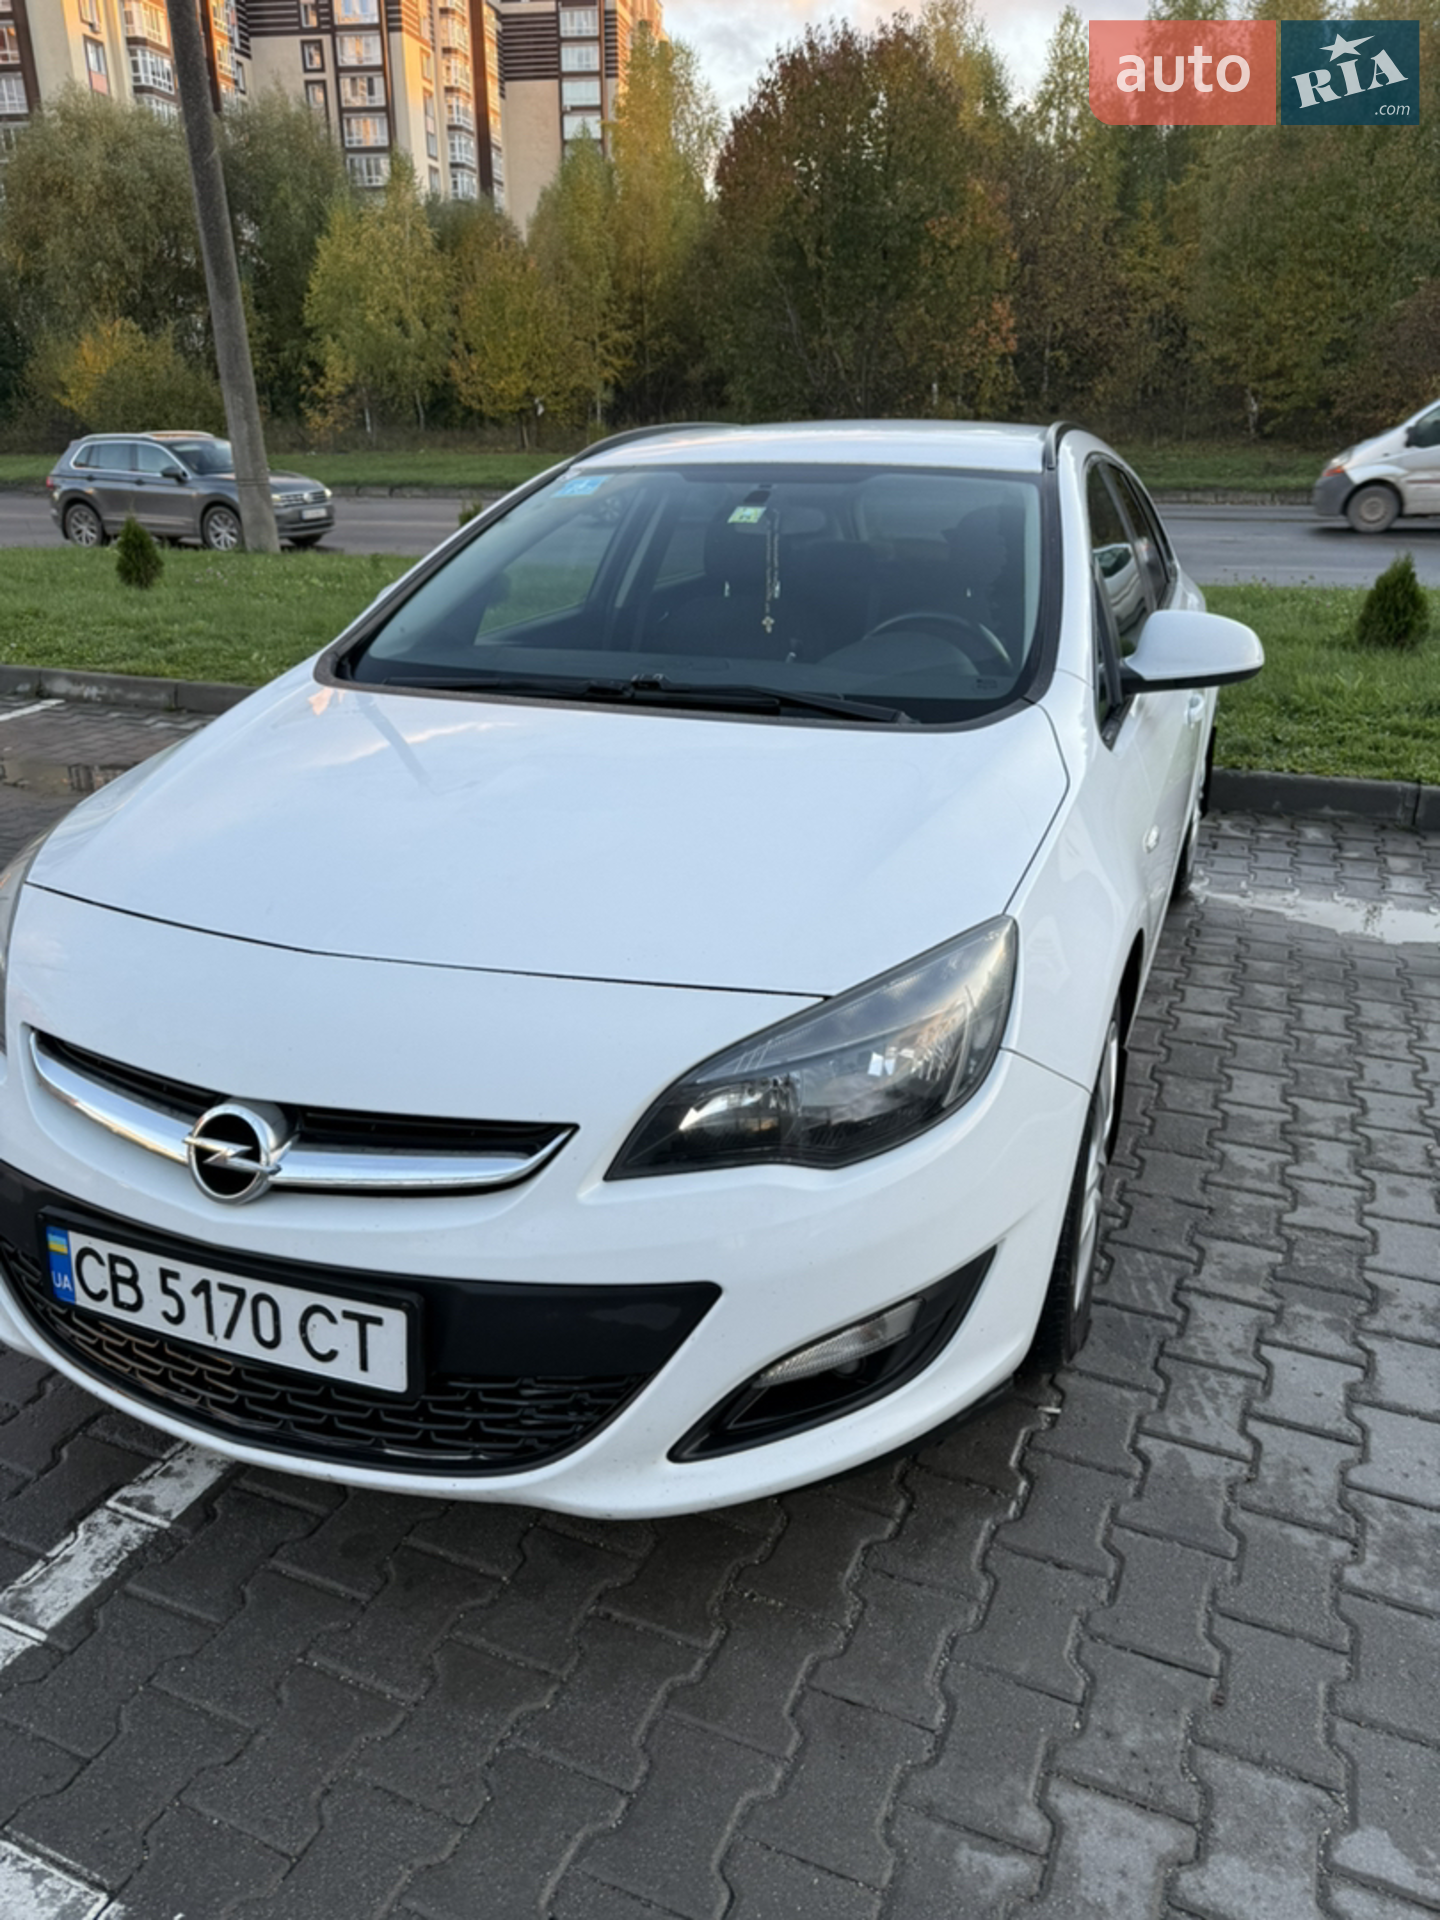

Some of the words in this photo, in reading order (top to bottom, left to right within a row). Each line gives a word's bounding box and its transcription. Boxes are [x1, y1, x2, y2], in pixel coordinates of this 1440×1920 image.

[52, 1270, 73, 1292] UA
[74, 1247, 144, 1313] CB
[159, 1267, 282, 1350] 5170
[299, 1303, 384, 1372] CT
